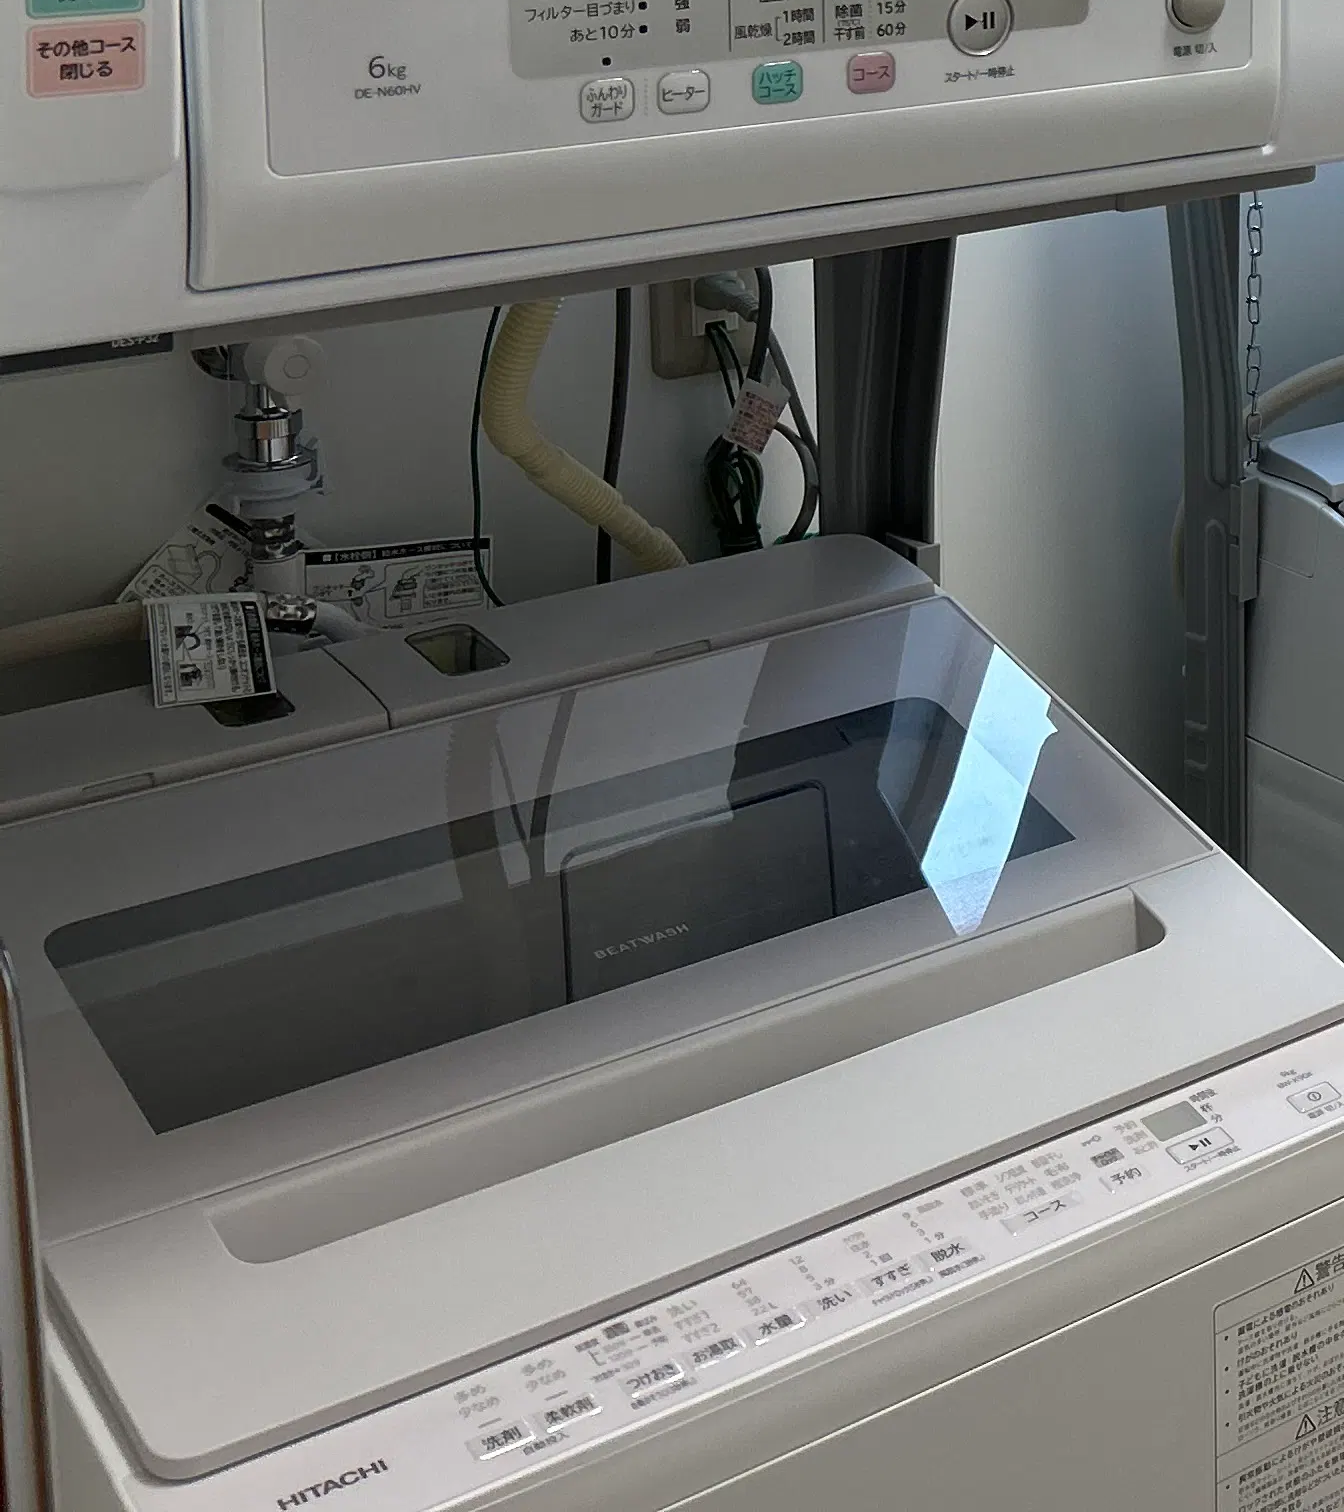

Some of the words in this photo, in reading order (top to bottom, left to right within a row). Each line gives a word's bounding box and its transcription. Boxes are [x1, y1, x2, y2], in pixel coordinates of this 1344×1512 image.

[524, 0, 636, 23] フィルター目づまり
[782, 7, 815, 24] 1時間
[835, 3, 863, 19] 除菌
[570, 22, 636, 43] あと10分
[675, 18, 691, 34] 弱
[734, 24, 773, 39] 風乾燥
[834, 25, 866, 41] 干す前
[876, 21, 907, 38] 60分
[783, 28, 816, 46] 2時間
[36, 36, 136, 59] その他コース
[59, 61, 113, 81] 閉じる
[368, 54, 407, 80] 6kg
[852, 64, 891, 82] コース
[758, 68, 795, 85] ハッチ
[661, 85, 706, 103] ヒーター
[758, 82, 796, 99] コース
[590, 101, 623, 118] ガード
[1110, 1166, 1142, 1185] 予約
[1022, 1199, 1067, 1224] コース
[930, 1241, 966, 1263] 脱水
[871, 1264, 912, 1288] すすぎ
[820, 1290, 853, 1310] 洗い
[480, 1425, 523, 1452] 洗剤
[276, 1457, 390, 1511] HITACHI
